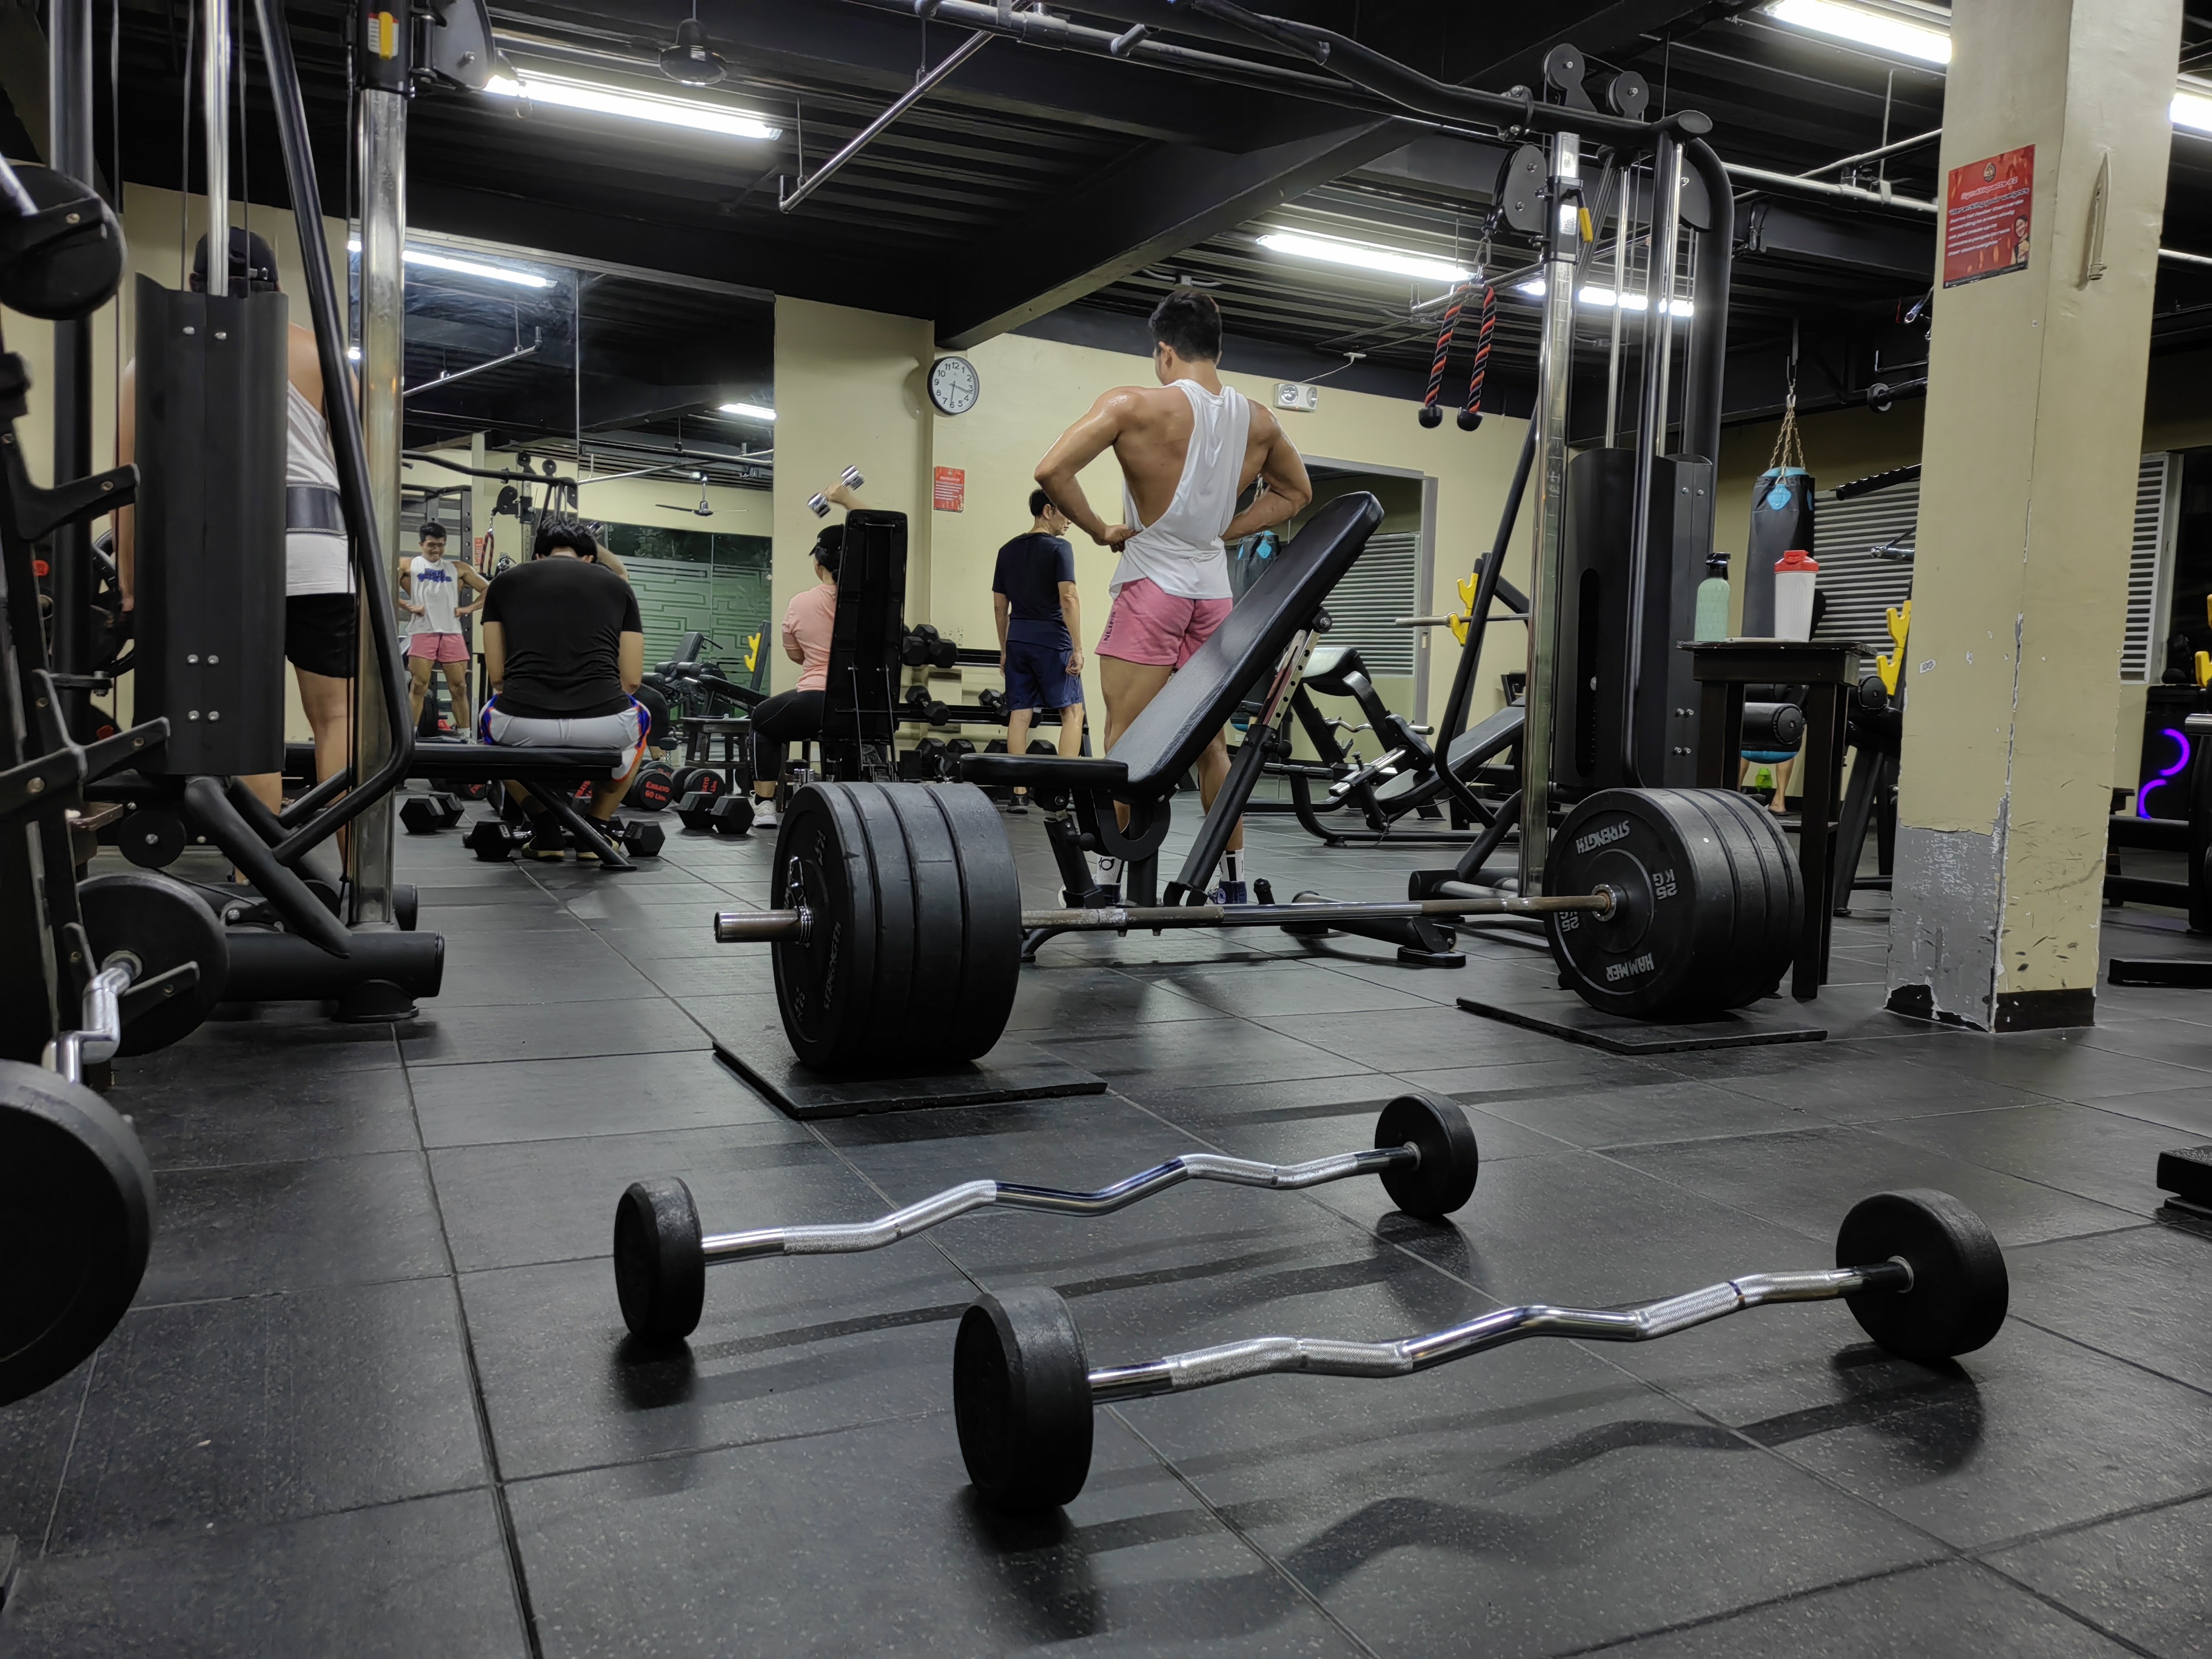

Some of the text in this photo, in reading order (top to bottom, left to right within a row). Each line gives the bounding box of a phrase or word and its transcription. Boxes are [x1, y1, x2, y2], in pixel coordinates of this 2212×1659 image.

[952, 361, 959, 370] 12
[1575, 820, 1631, 854] STRENGTH
[1652, 869, 1675, 886] KG
[1656, 882, 1678, 900] 25
[1561, 917, 1580, 932] 25
[1606, 952, 1655, 982] HAMMER
